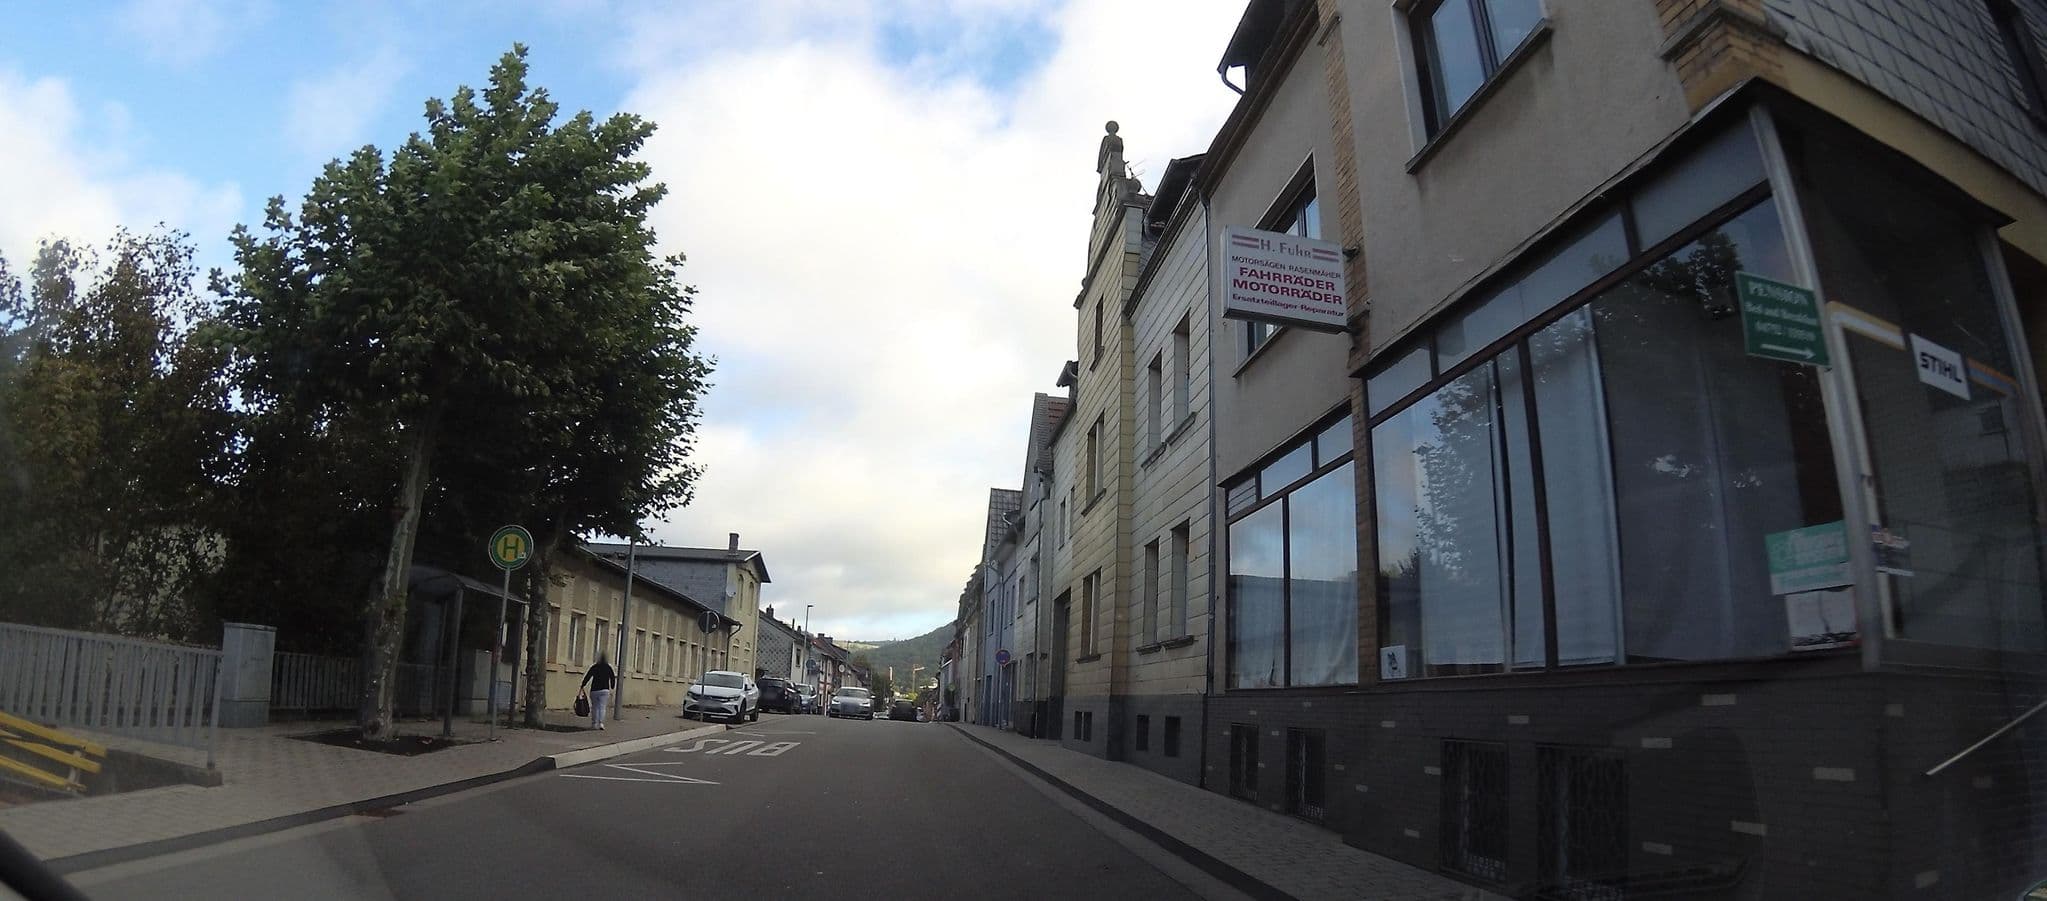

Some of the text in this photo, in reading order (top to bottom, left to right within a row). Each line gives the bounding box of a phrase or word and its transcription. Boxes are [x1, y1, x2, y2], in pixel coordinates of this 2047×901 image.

[1260, 239, 1276, 253] H.
[1231, 255, 1286, 271] MOTORSÄGEN
[1239, 266, 1335, 292] FAHRRÄDER
[1232, 278, 1343, 305] MOTORRÄDER
[1920, 351, 1962, 384] STIHL
[502, 536, 519, 560] H
[663, 738, 801, 757] BUS
